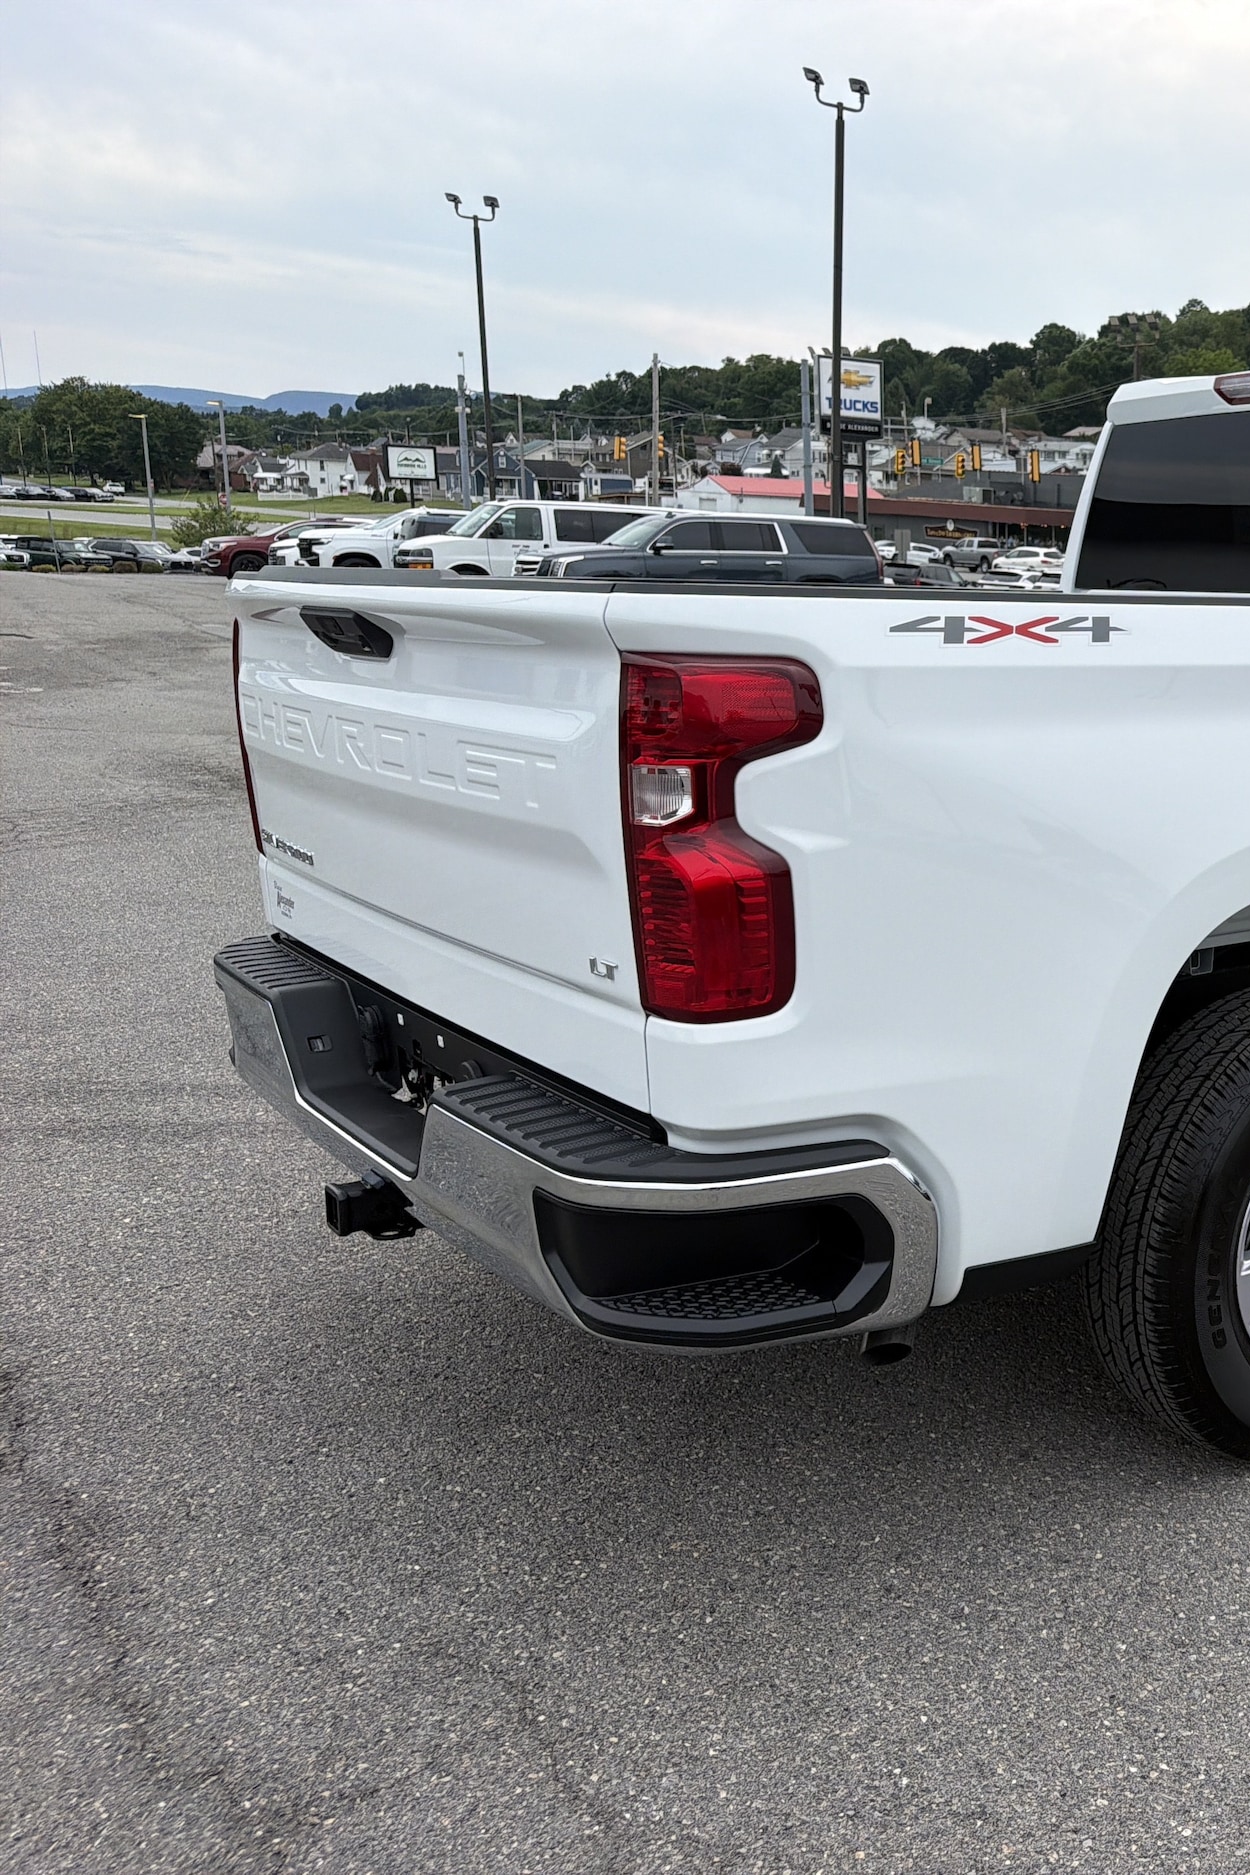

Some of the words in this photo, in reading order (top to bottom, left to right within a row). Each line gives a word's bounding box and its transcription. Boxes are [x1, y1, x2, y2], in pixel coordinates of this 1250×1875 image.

[825, 396, 878, 413] TUCKS
[847, 423, 879, 432] ALEXANDER
[889, 615, 1129, 644] 4X4
[239, 692, 557, 809] CHEVROLET
[589, 956, 618, 981] LT
